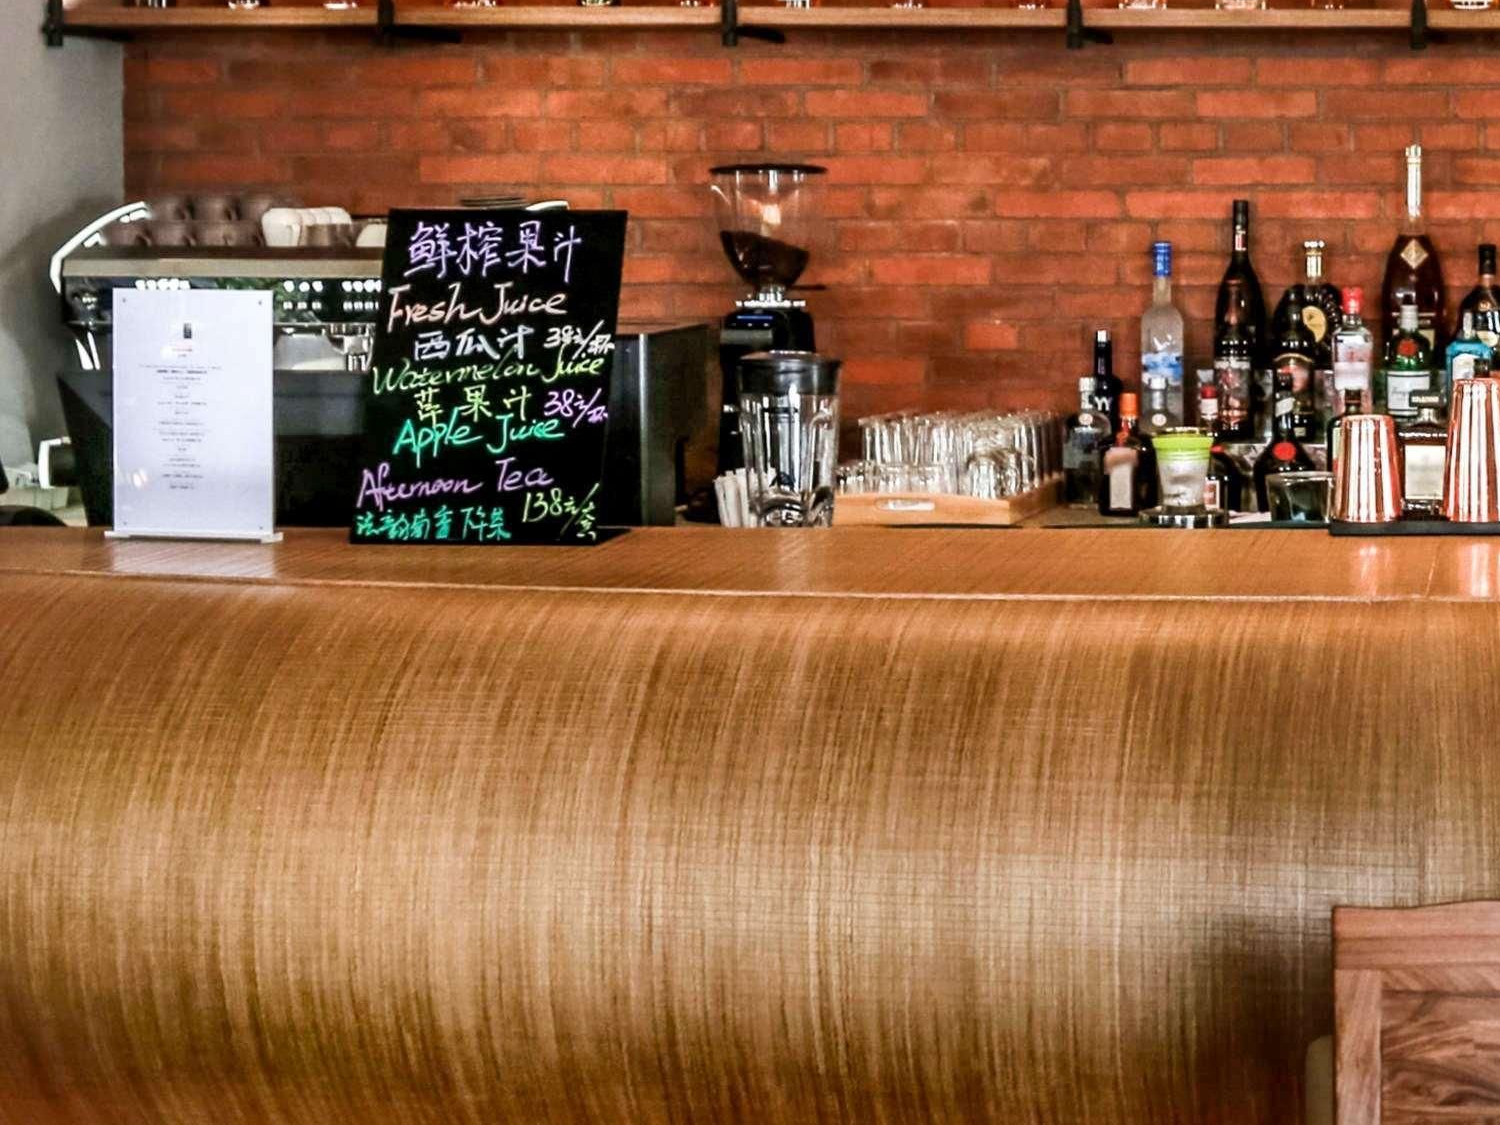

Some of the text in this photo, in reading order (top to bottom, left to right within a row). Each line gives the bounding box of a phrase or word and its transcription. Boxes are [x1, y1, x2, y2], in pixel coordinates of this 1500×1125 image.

[404, 220, 582, 282] 鲜榨果汁
[387, 281, 568, 333] Fresh Juice
[414, 325, 535, 361] 西瓜汁
[373, 344, 604, 395] Watermelon Juice
[414, 385, 532, 425] 苹果汁
[393, 407, 566, 468] Apple Juice
[495, 457, 554, 492] Tea
